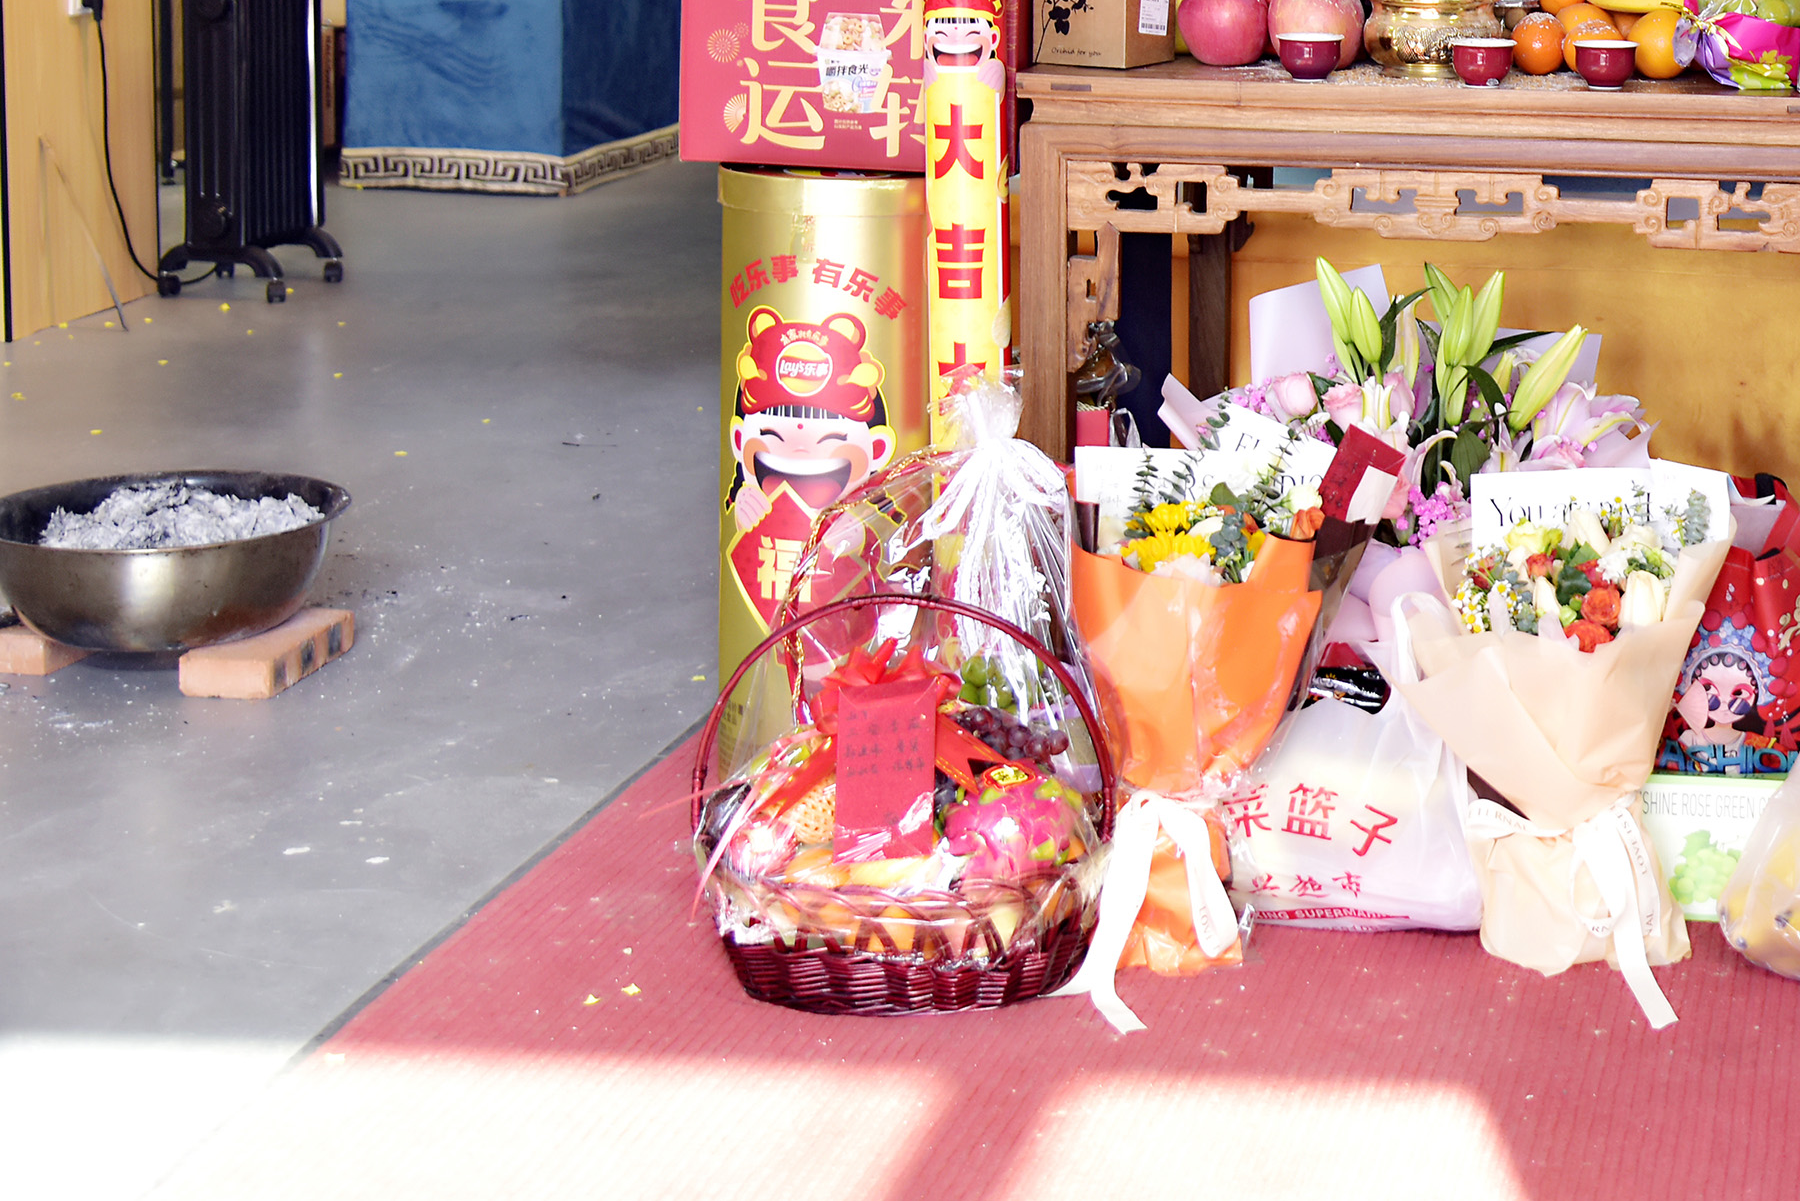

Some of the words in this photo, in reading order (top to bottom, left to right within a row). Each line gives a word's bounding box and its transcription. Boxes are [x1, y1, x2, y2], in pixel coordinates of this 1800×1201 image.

[812, 257, 907, 321] 有乐事
[1223, 783, 1398, 857] 菜篮子
[1682, 793, 1712, 817] ROSE
[1715, 794, 1756, 819] GREEN
